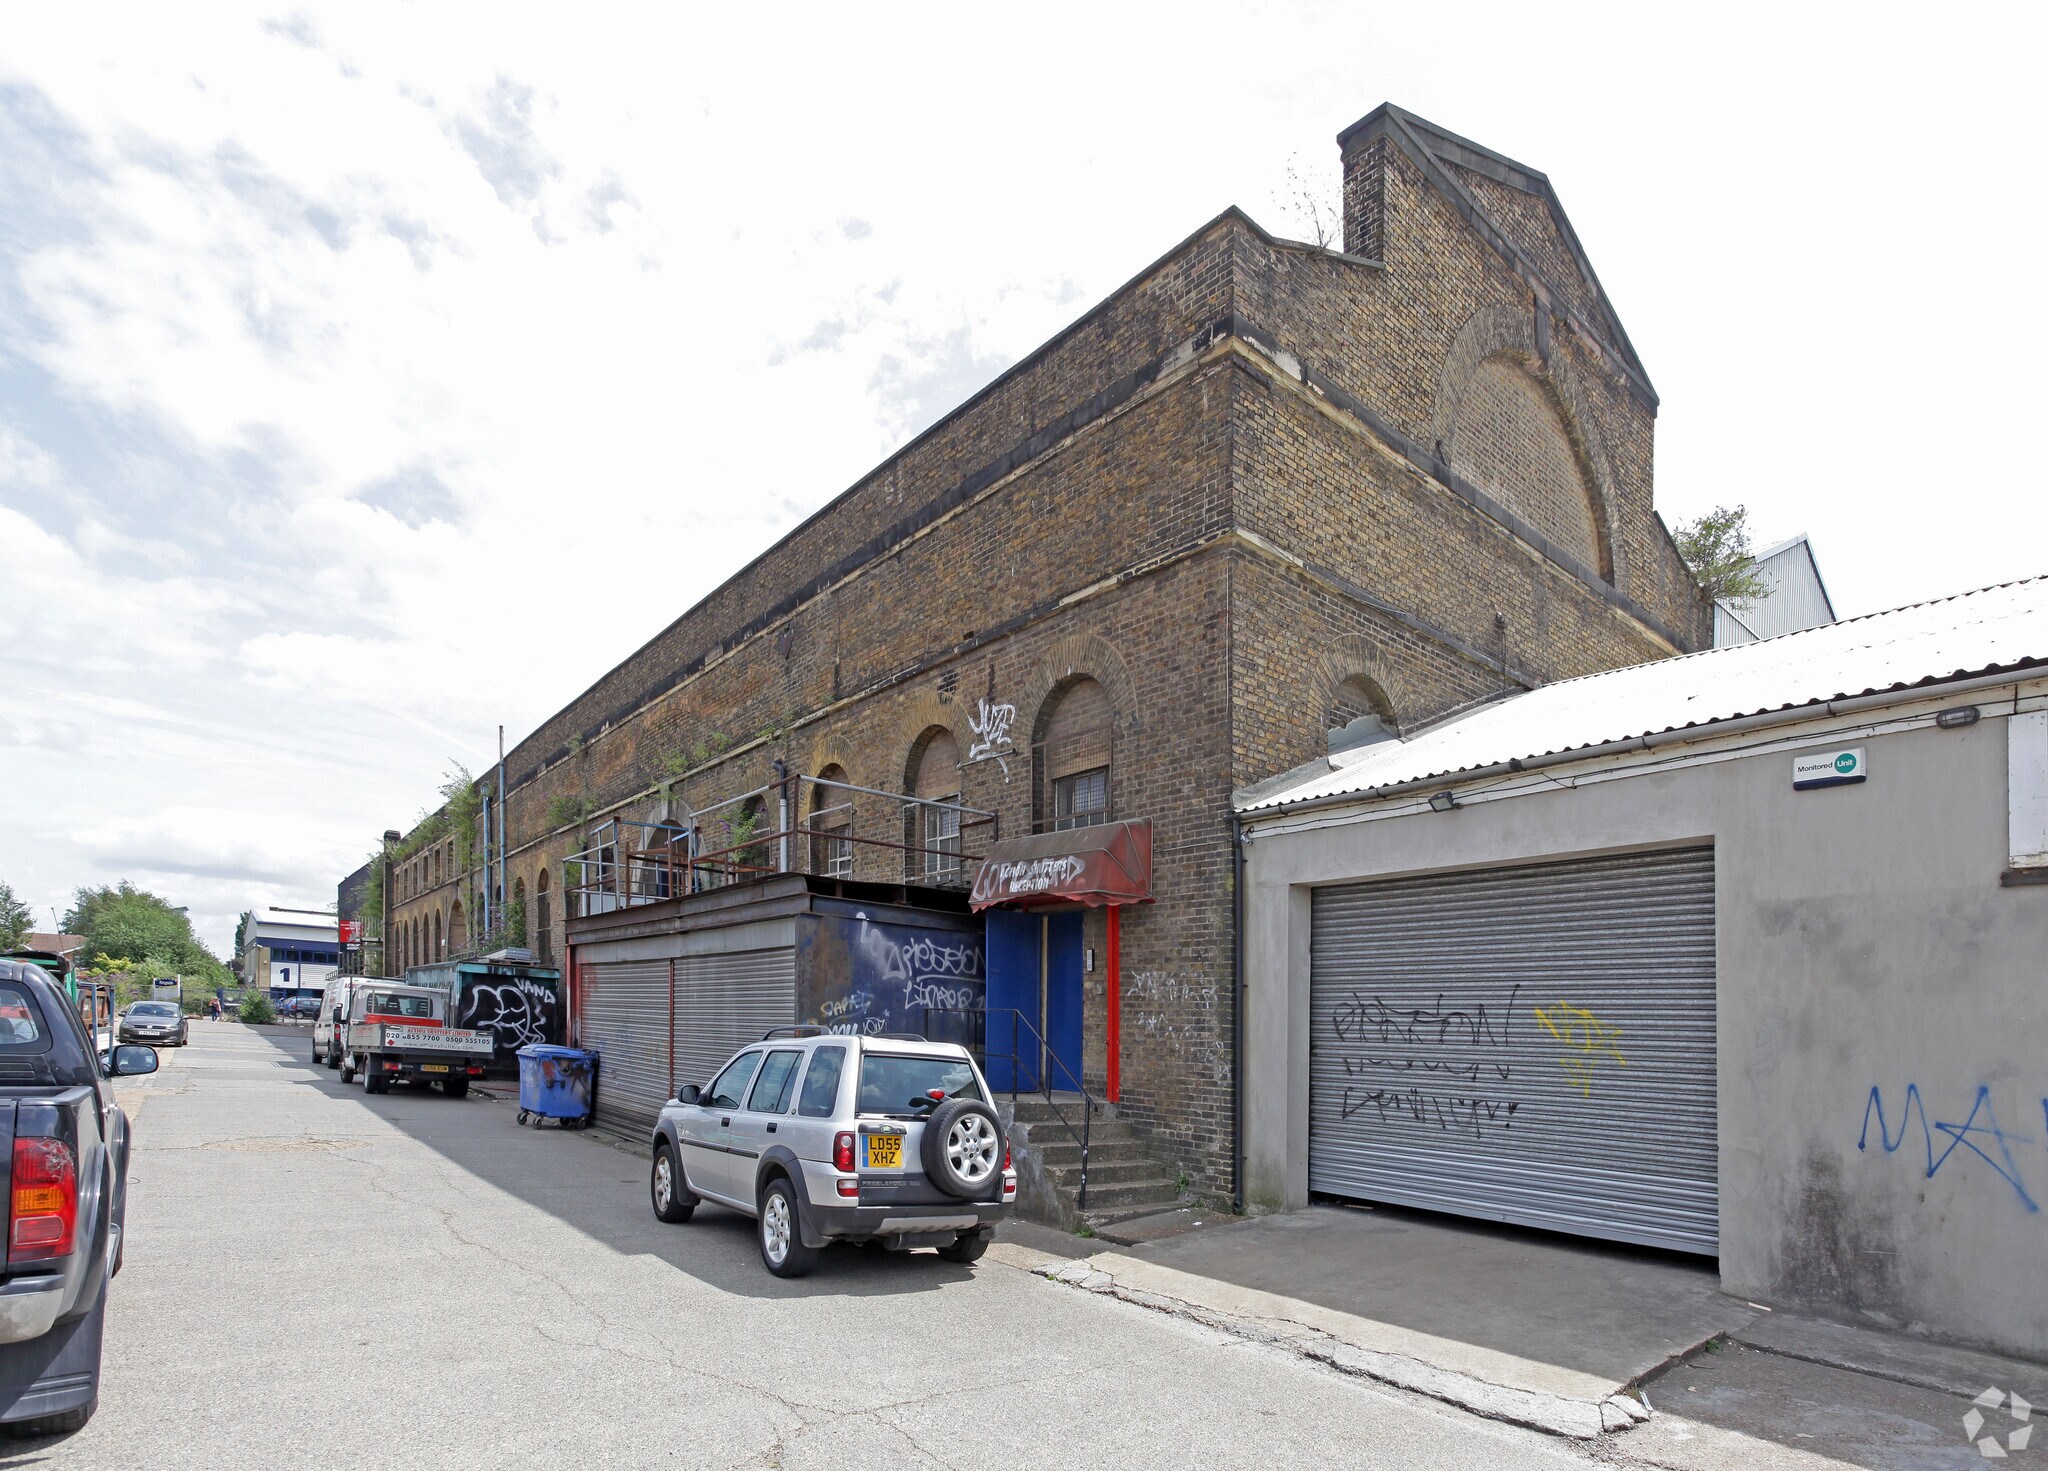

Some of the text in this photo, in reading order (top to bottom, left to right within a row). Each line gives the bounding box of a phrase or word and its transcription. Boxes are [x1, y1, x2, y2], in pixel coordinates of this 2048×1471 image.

[1797, 759, 1854, 773] Monitored Unit
[1009, 878, 1049, 893] RECEPTION
[280, 967, 291, 982] 1
[869, 1137, 900, 1150] LD55
[873, 1151, 896, 1164] XHZ
